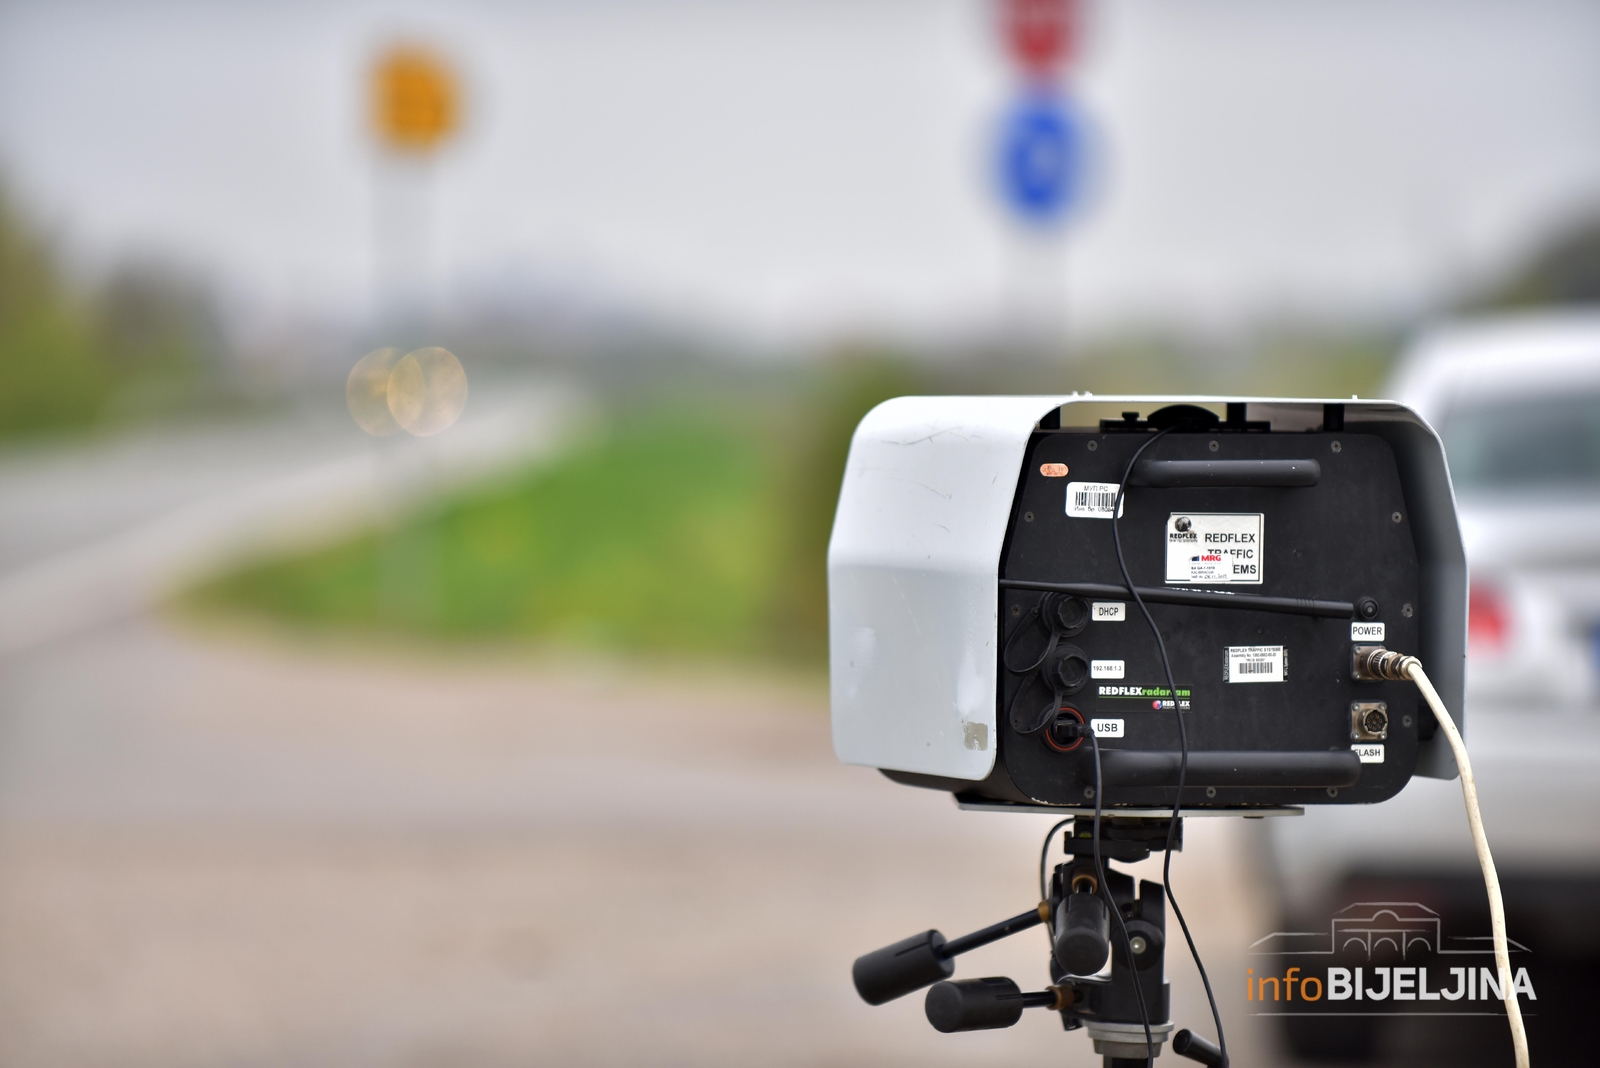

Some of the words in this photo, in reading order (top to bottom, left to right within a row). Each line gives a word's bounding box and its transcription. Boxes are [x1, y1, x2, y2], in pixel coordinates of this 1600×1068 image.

[1204, 533, 1256, 543] REDFLEX
[1099, 607, 1118, 616] DHCP
[1352, 626, 1382, 636] POWER
[1099, 686, 1190, 696] REDFLEXradaram
[1097, 723, 1118, 732] USB
